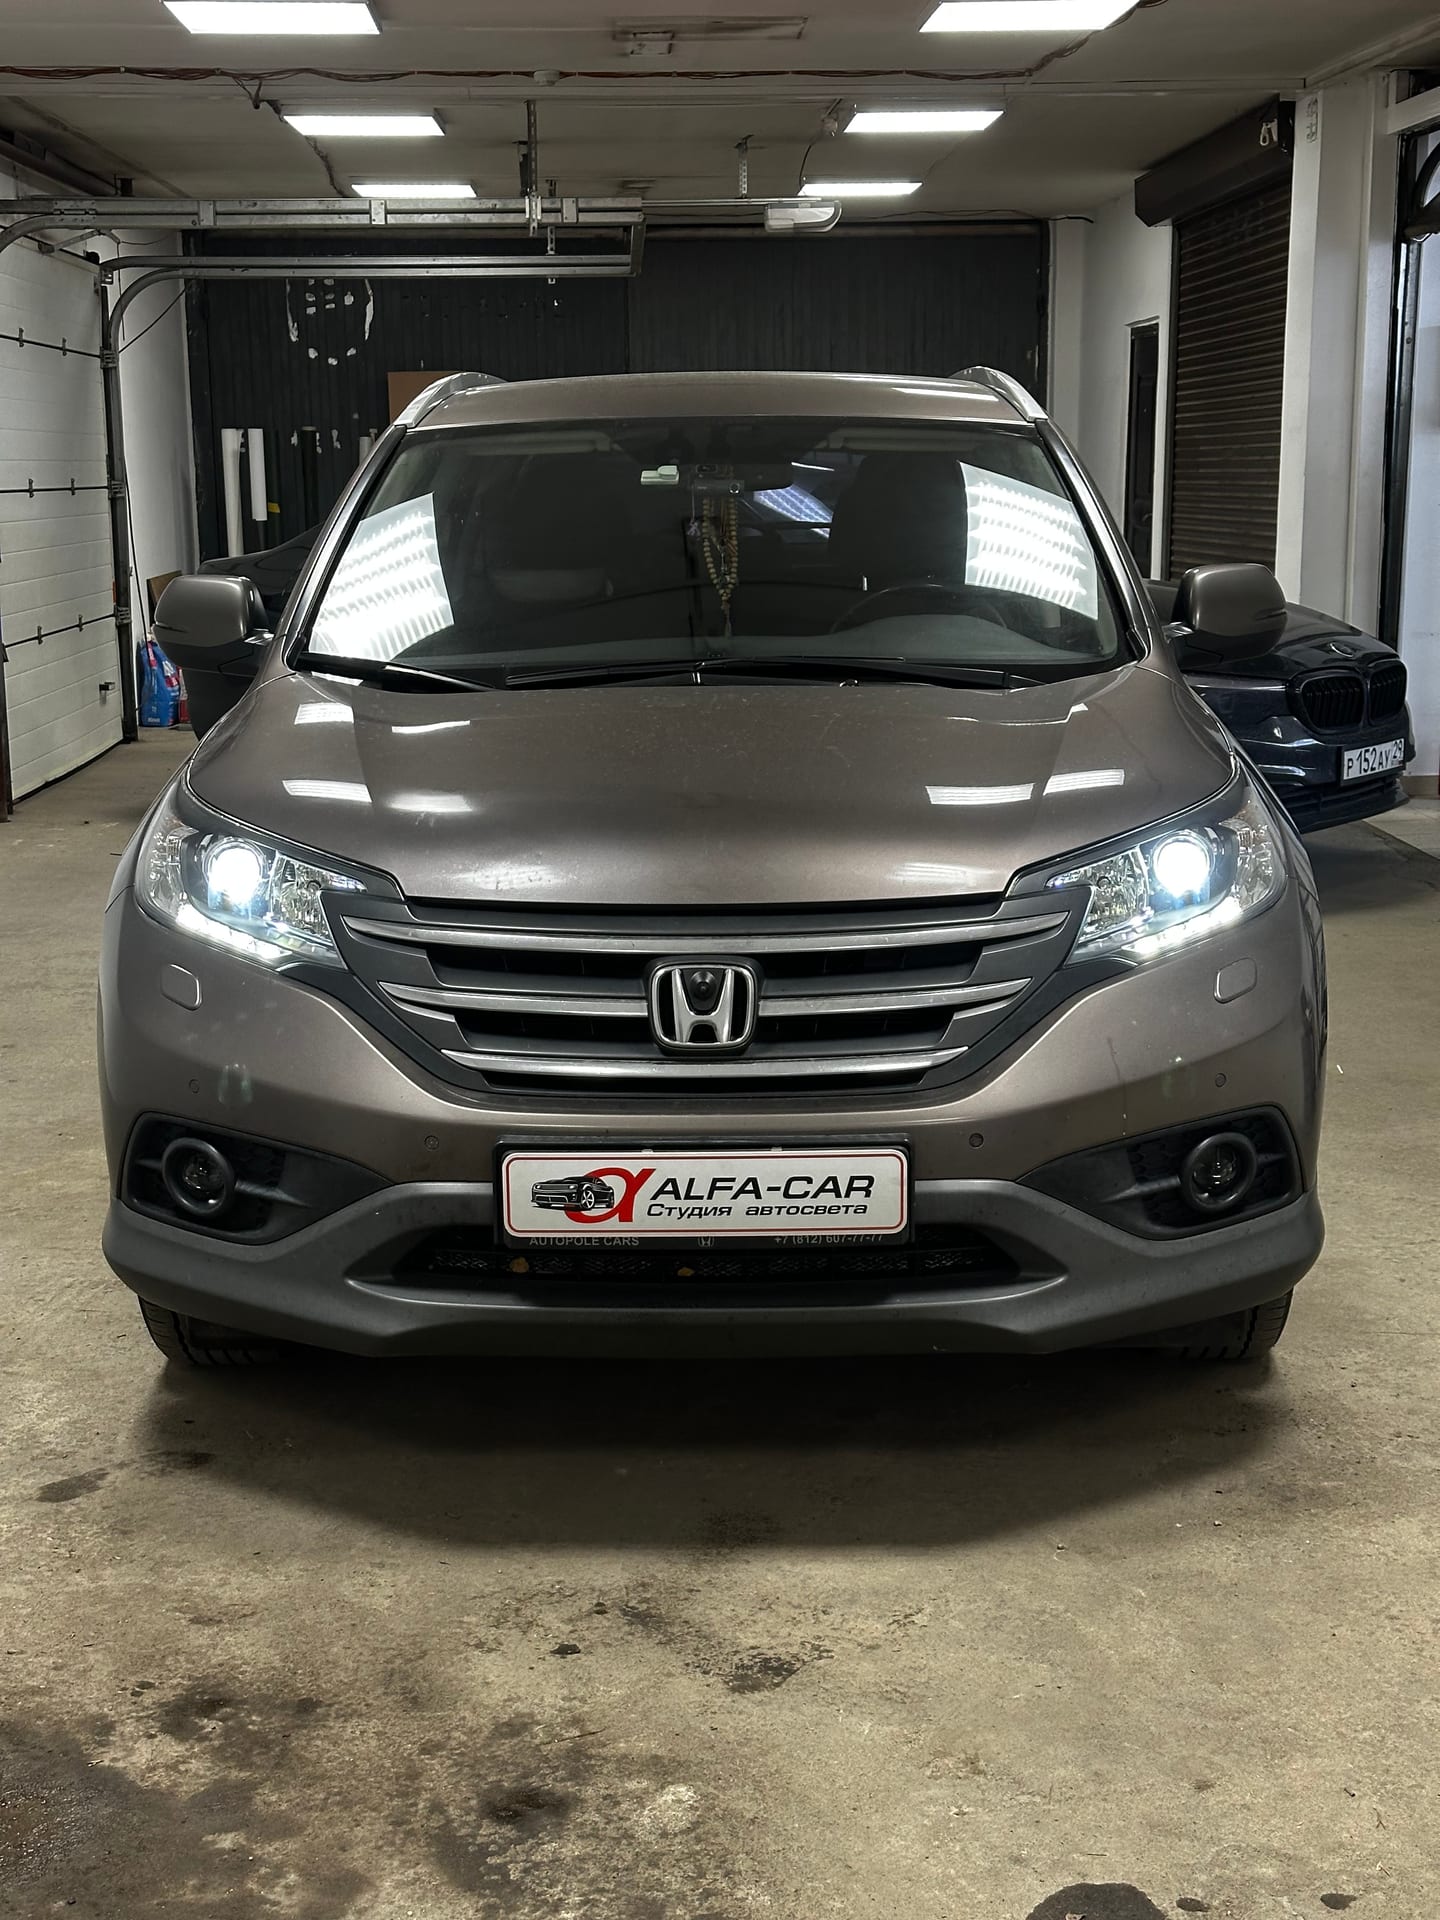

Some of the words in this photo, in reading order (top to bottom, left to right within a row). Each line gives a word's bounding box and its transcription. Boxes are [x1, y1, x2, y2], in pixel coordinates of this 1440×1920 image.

[650, 1175, 875, 1201] ALFA-CAR
[647, 1203, 733, 1219] Студия
[745, 1204, 868, 1216] автосвета
[529, 1236, 600, 1246] AUTOPOLE
[603, 1236, 640, 1246] CARS
